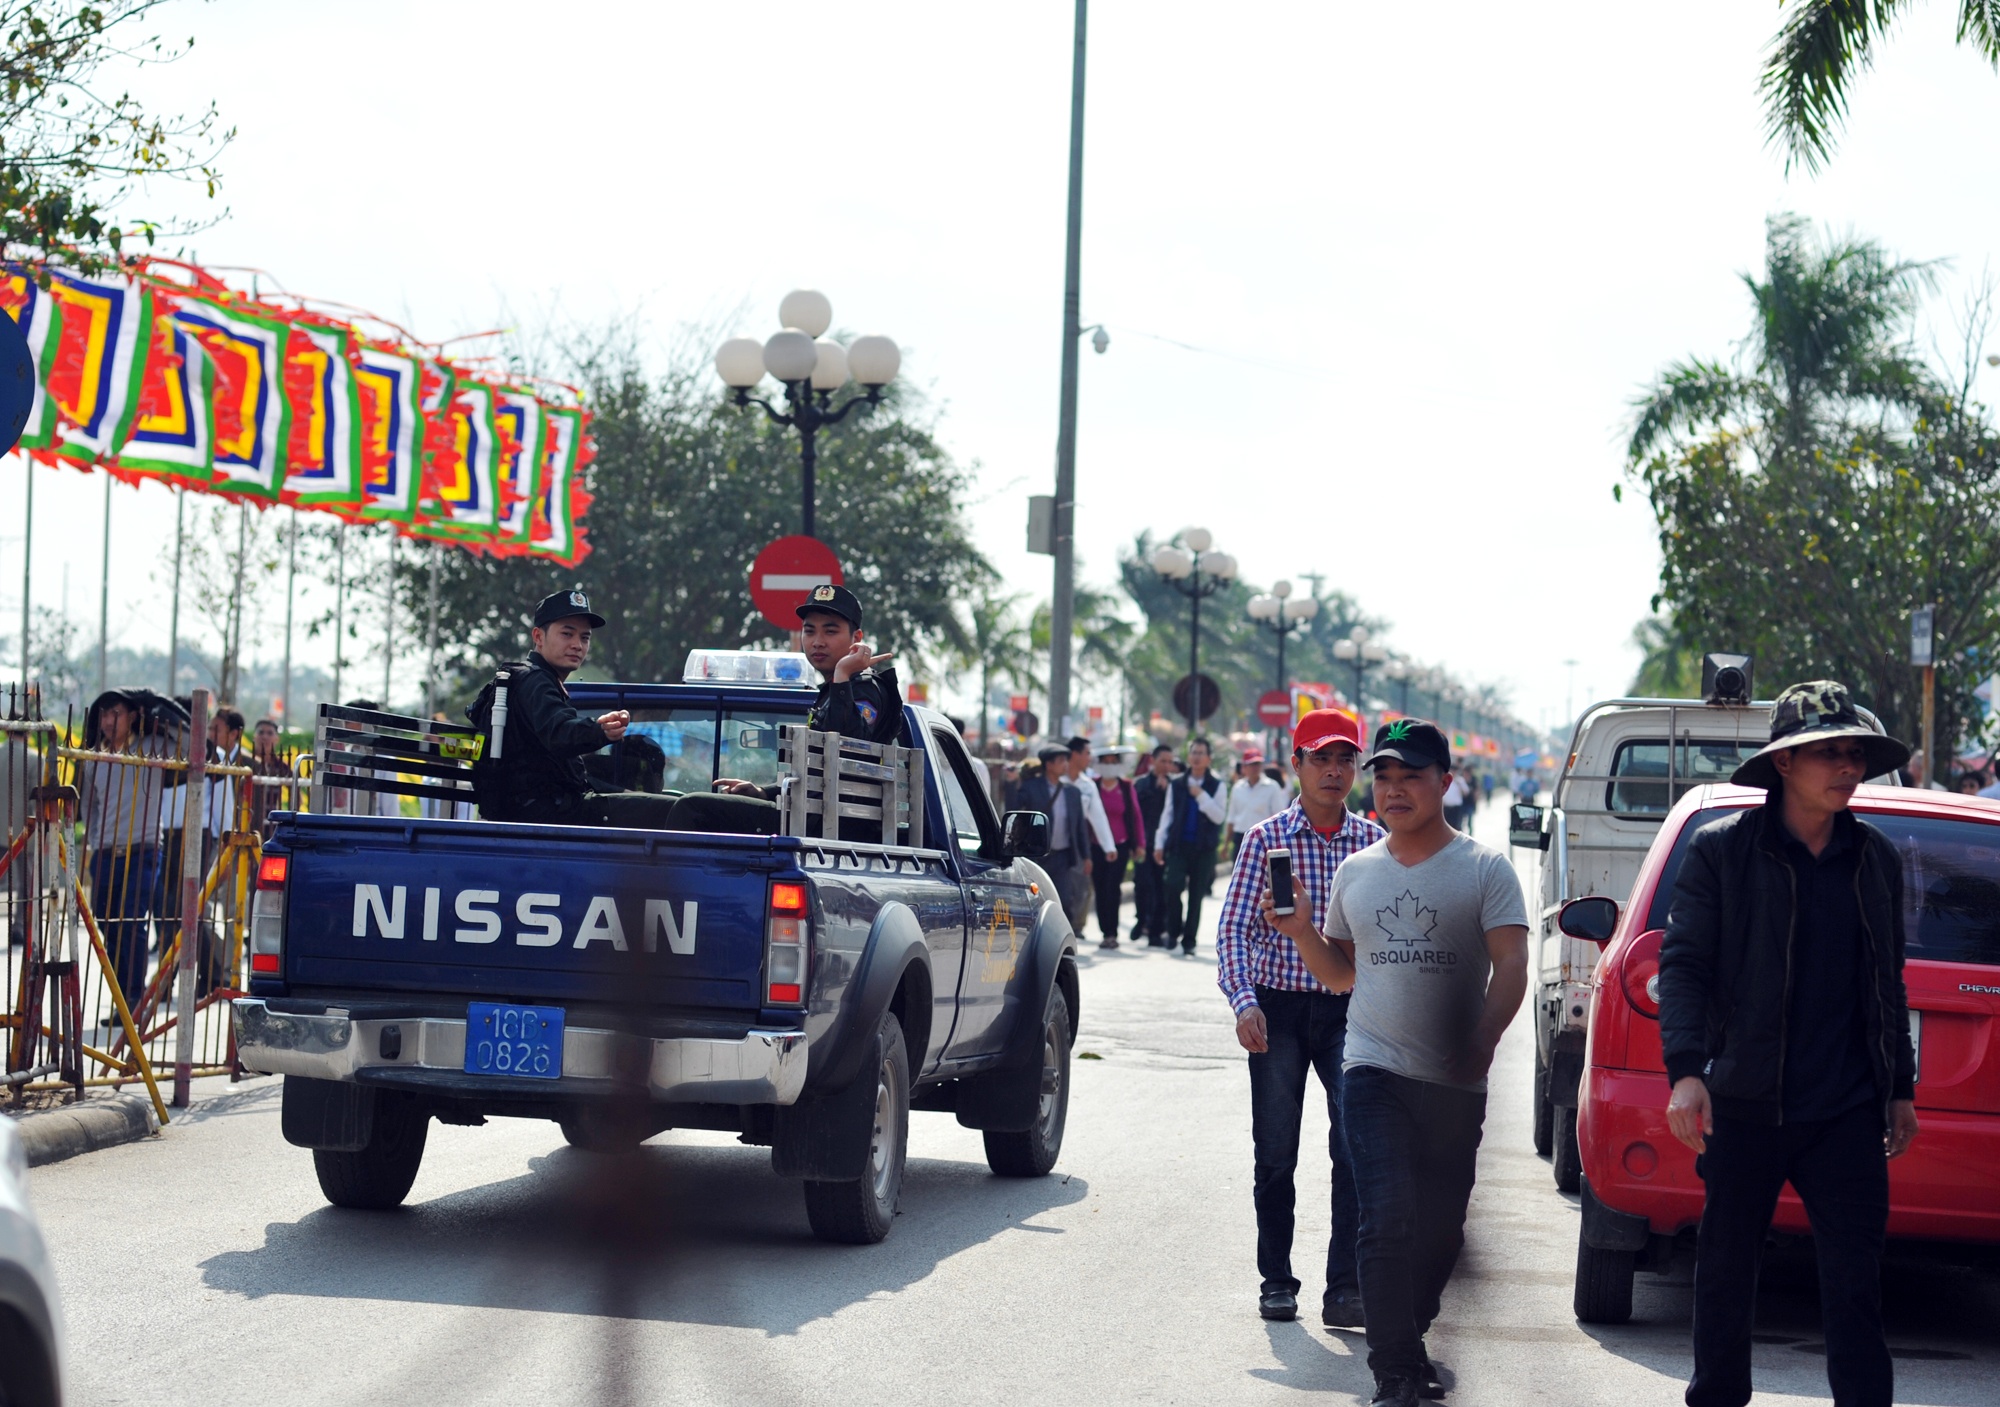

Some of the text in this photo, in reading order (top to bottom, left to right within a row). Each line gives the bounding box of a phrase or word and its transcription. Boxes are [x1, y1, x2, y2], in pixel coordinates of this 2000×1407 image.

[352, 883, 699, 955] NISSAN
[1370, 949, 1457, 966] DSQUARED
[1418, 966, 1440, 975] SINSE
[477, 1040, 550, 1073] 0826
